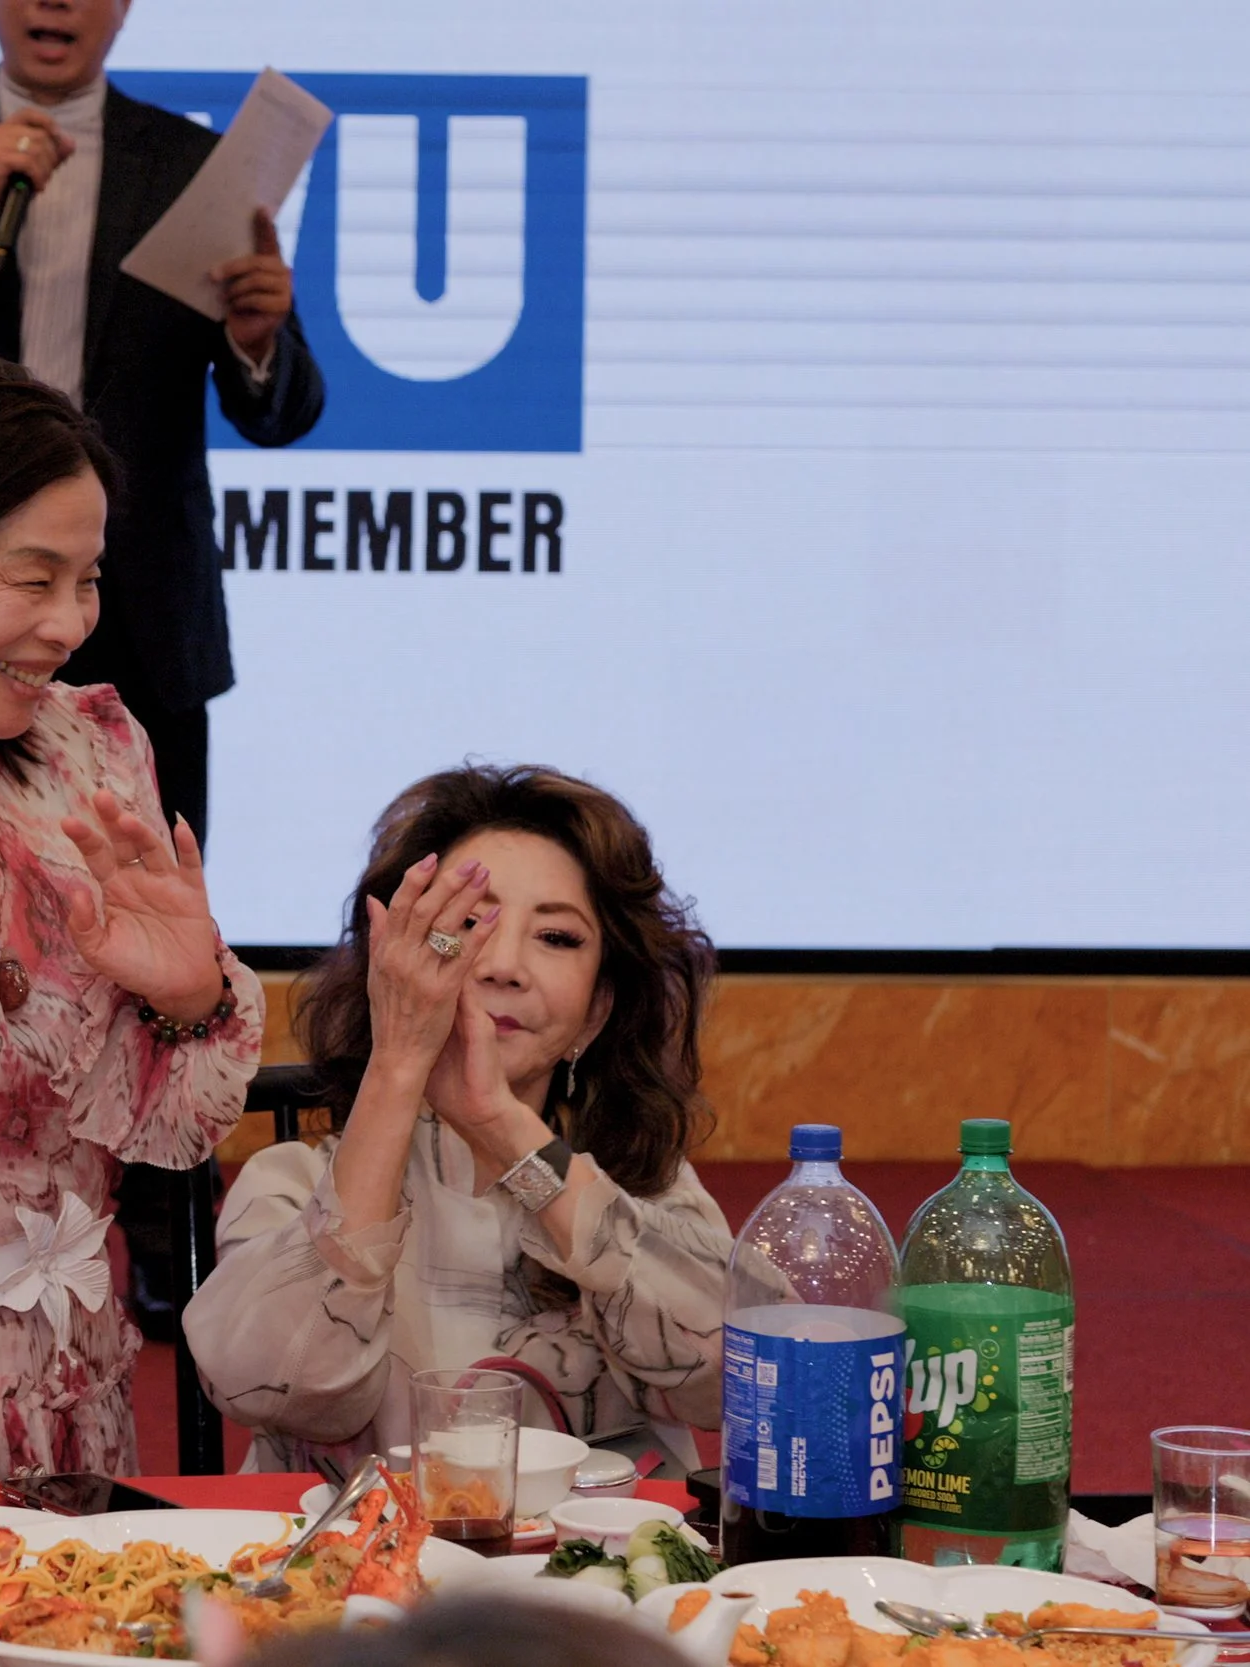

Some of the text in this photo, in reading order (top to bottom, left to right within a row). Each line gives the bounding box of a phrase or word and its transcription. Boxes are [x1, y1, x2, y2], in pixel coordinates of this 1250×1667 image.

[290, 113, 527, 382] U
[221, 490, 564, 573] MEMBER
[869, 1351, 895, 1501] PEPSI
[798, 1437, 806, 1497] RECYCLE
[936, 1491, 957, 1503] SODA
[937, 1472, 971, 1494] LIME
